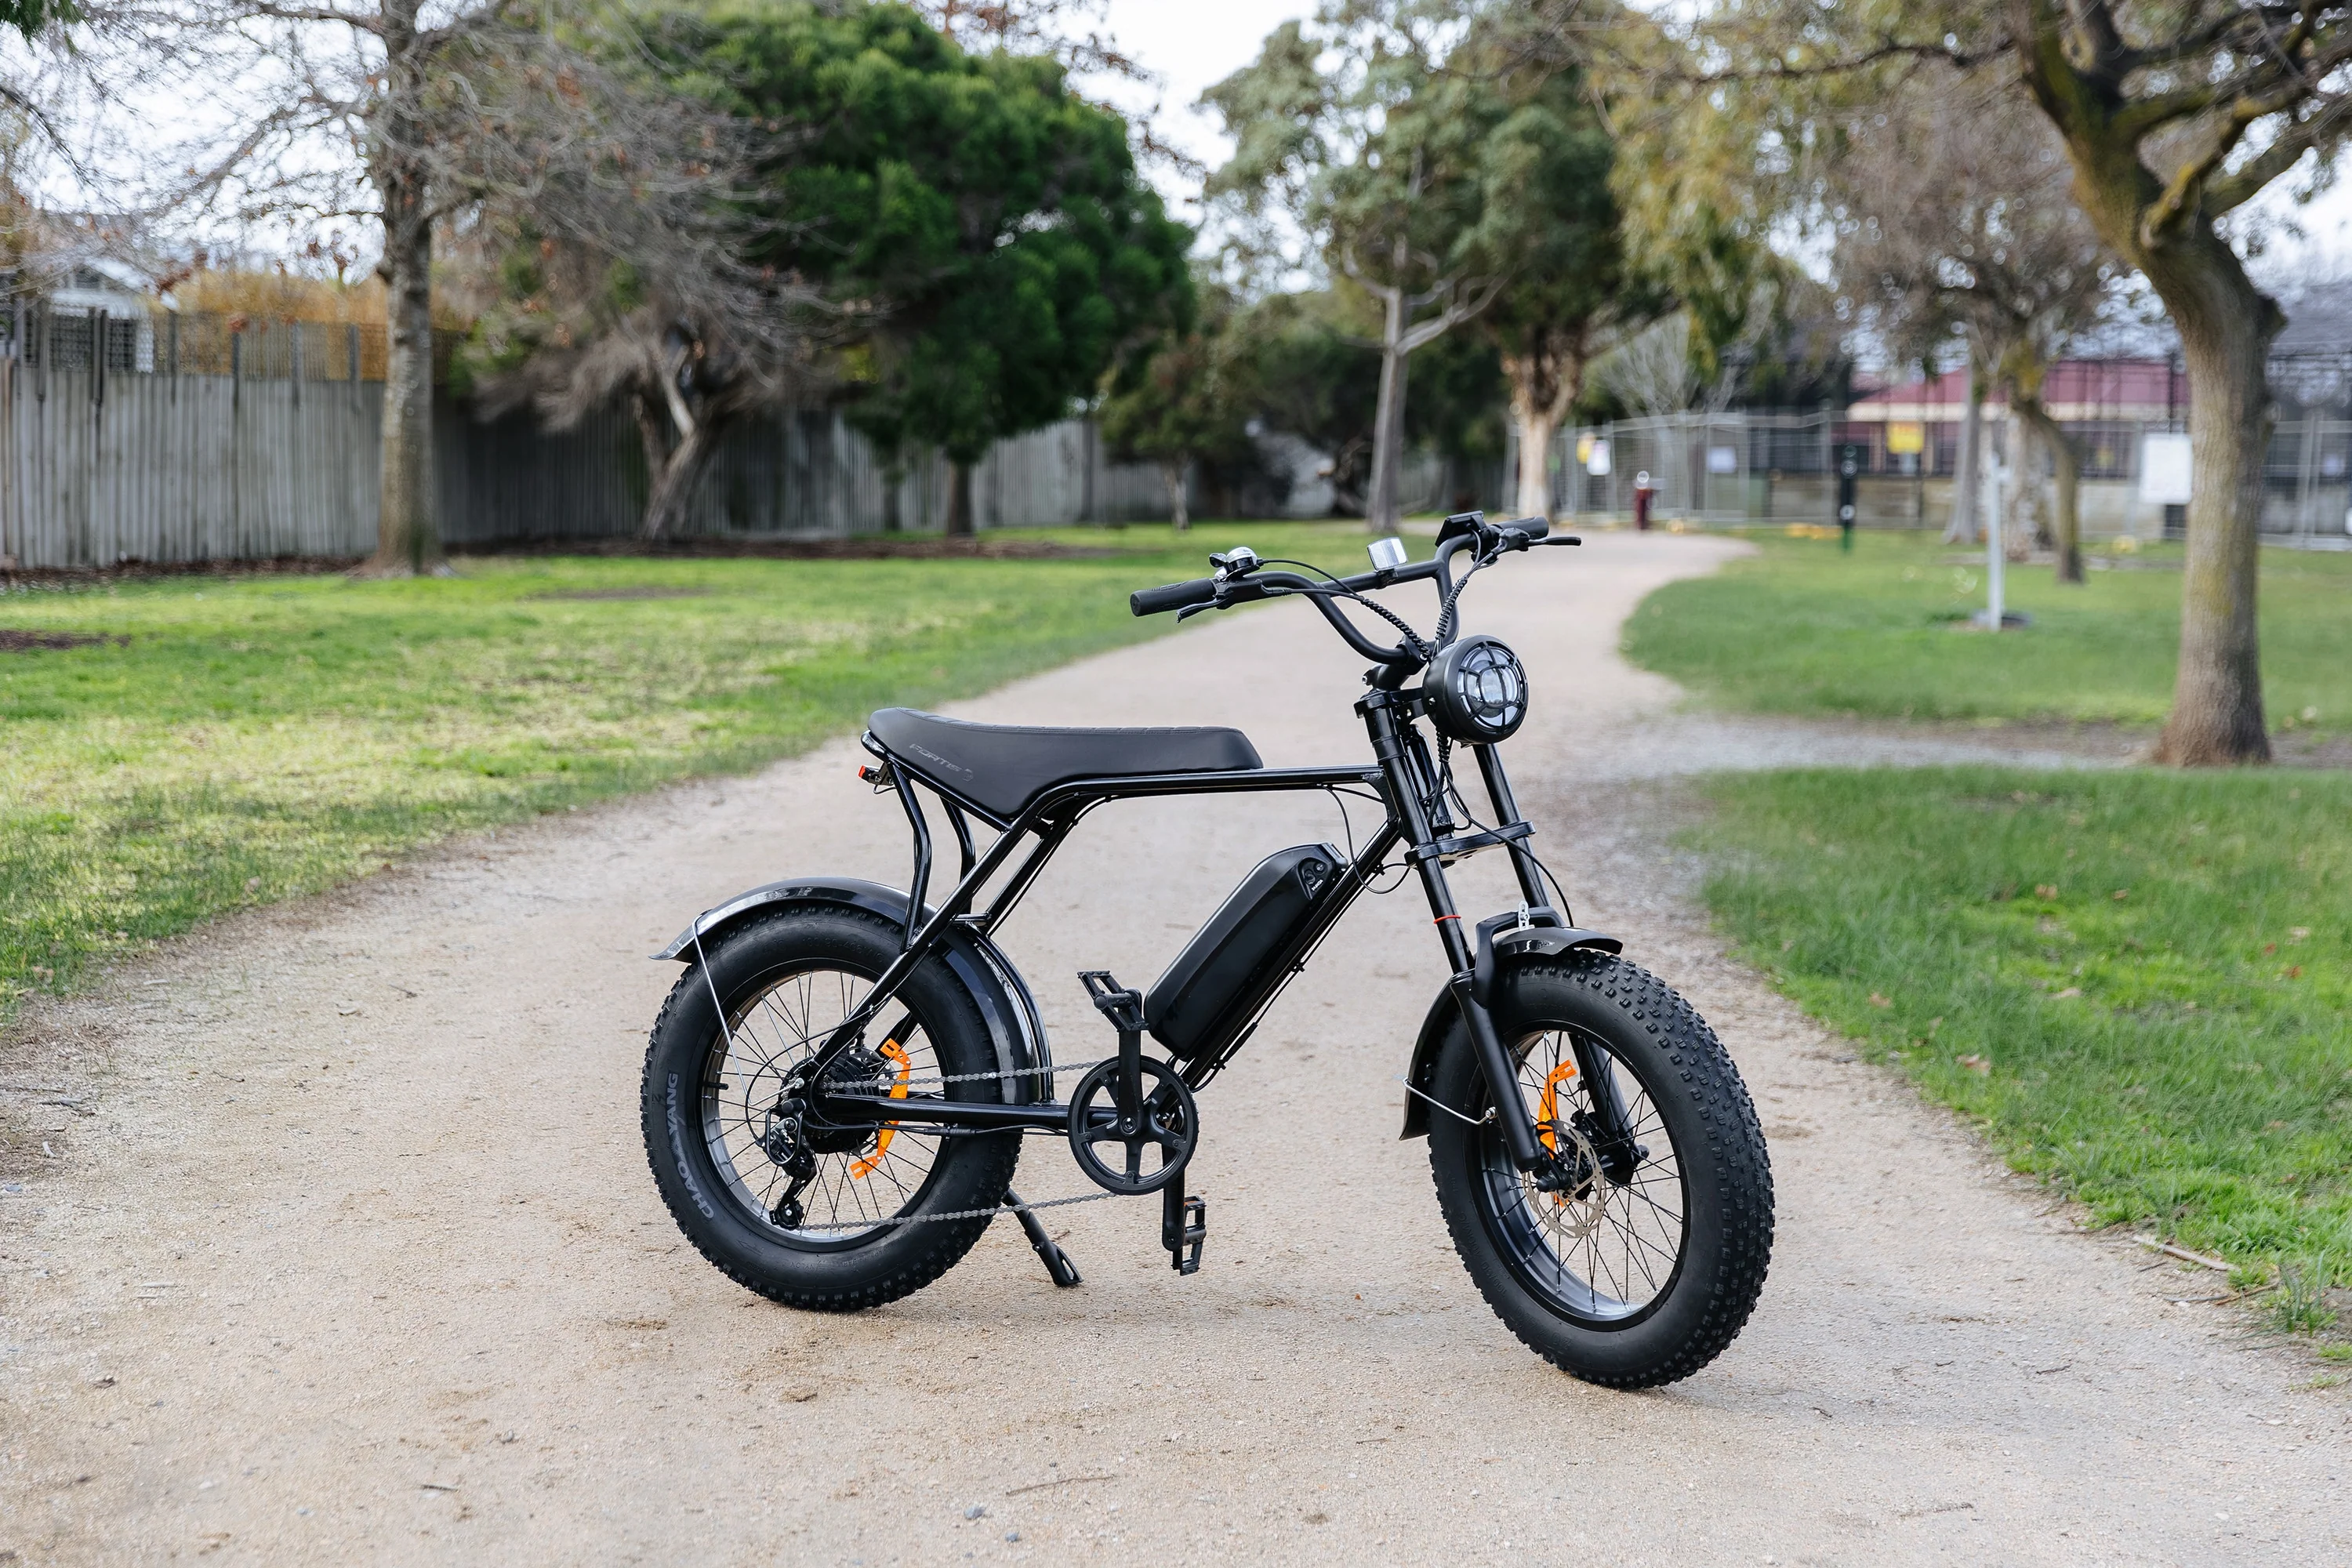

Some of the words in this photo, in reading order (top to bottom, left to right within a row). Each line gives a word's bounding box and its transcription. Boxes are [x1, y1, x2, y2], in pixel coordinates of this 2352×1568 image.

[909, 743, 962, 772] FORTIS
[666, 1073, 681, 1136] YANG
[677, 1160, 714, 1218] CHAO
